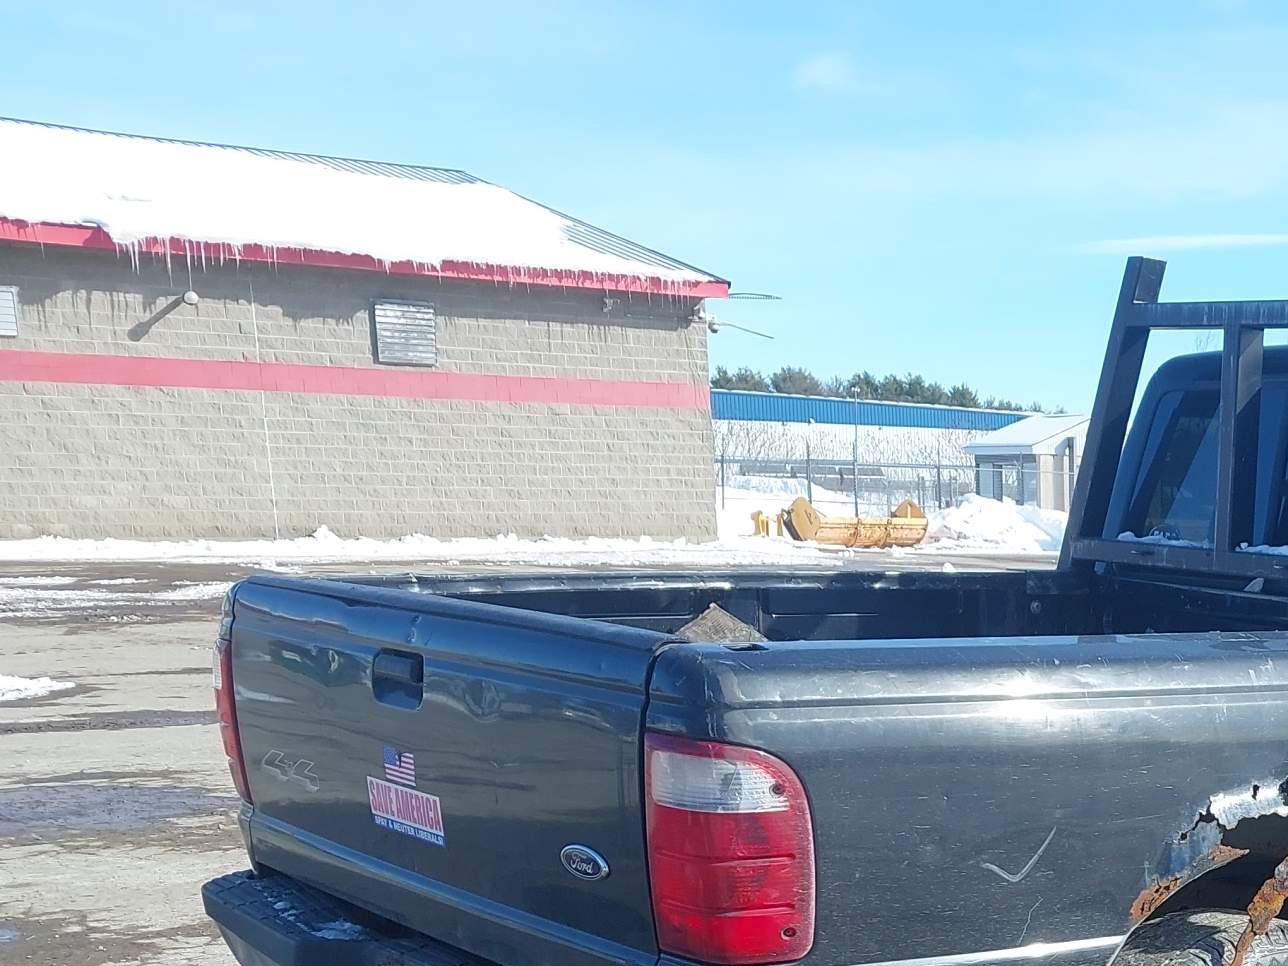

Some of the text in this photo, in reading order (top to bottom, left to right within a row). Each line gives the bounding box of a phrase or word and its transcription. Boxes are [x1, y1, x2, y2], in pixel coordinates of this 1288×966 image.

[369, 779, 442, 834] SAVE AMERICA
[570, 851, 595, 874] Ford
